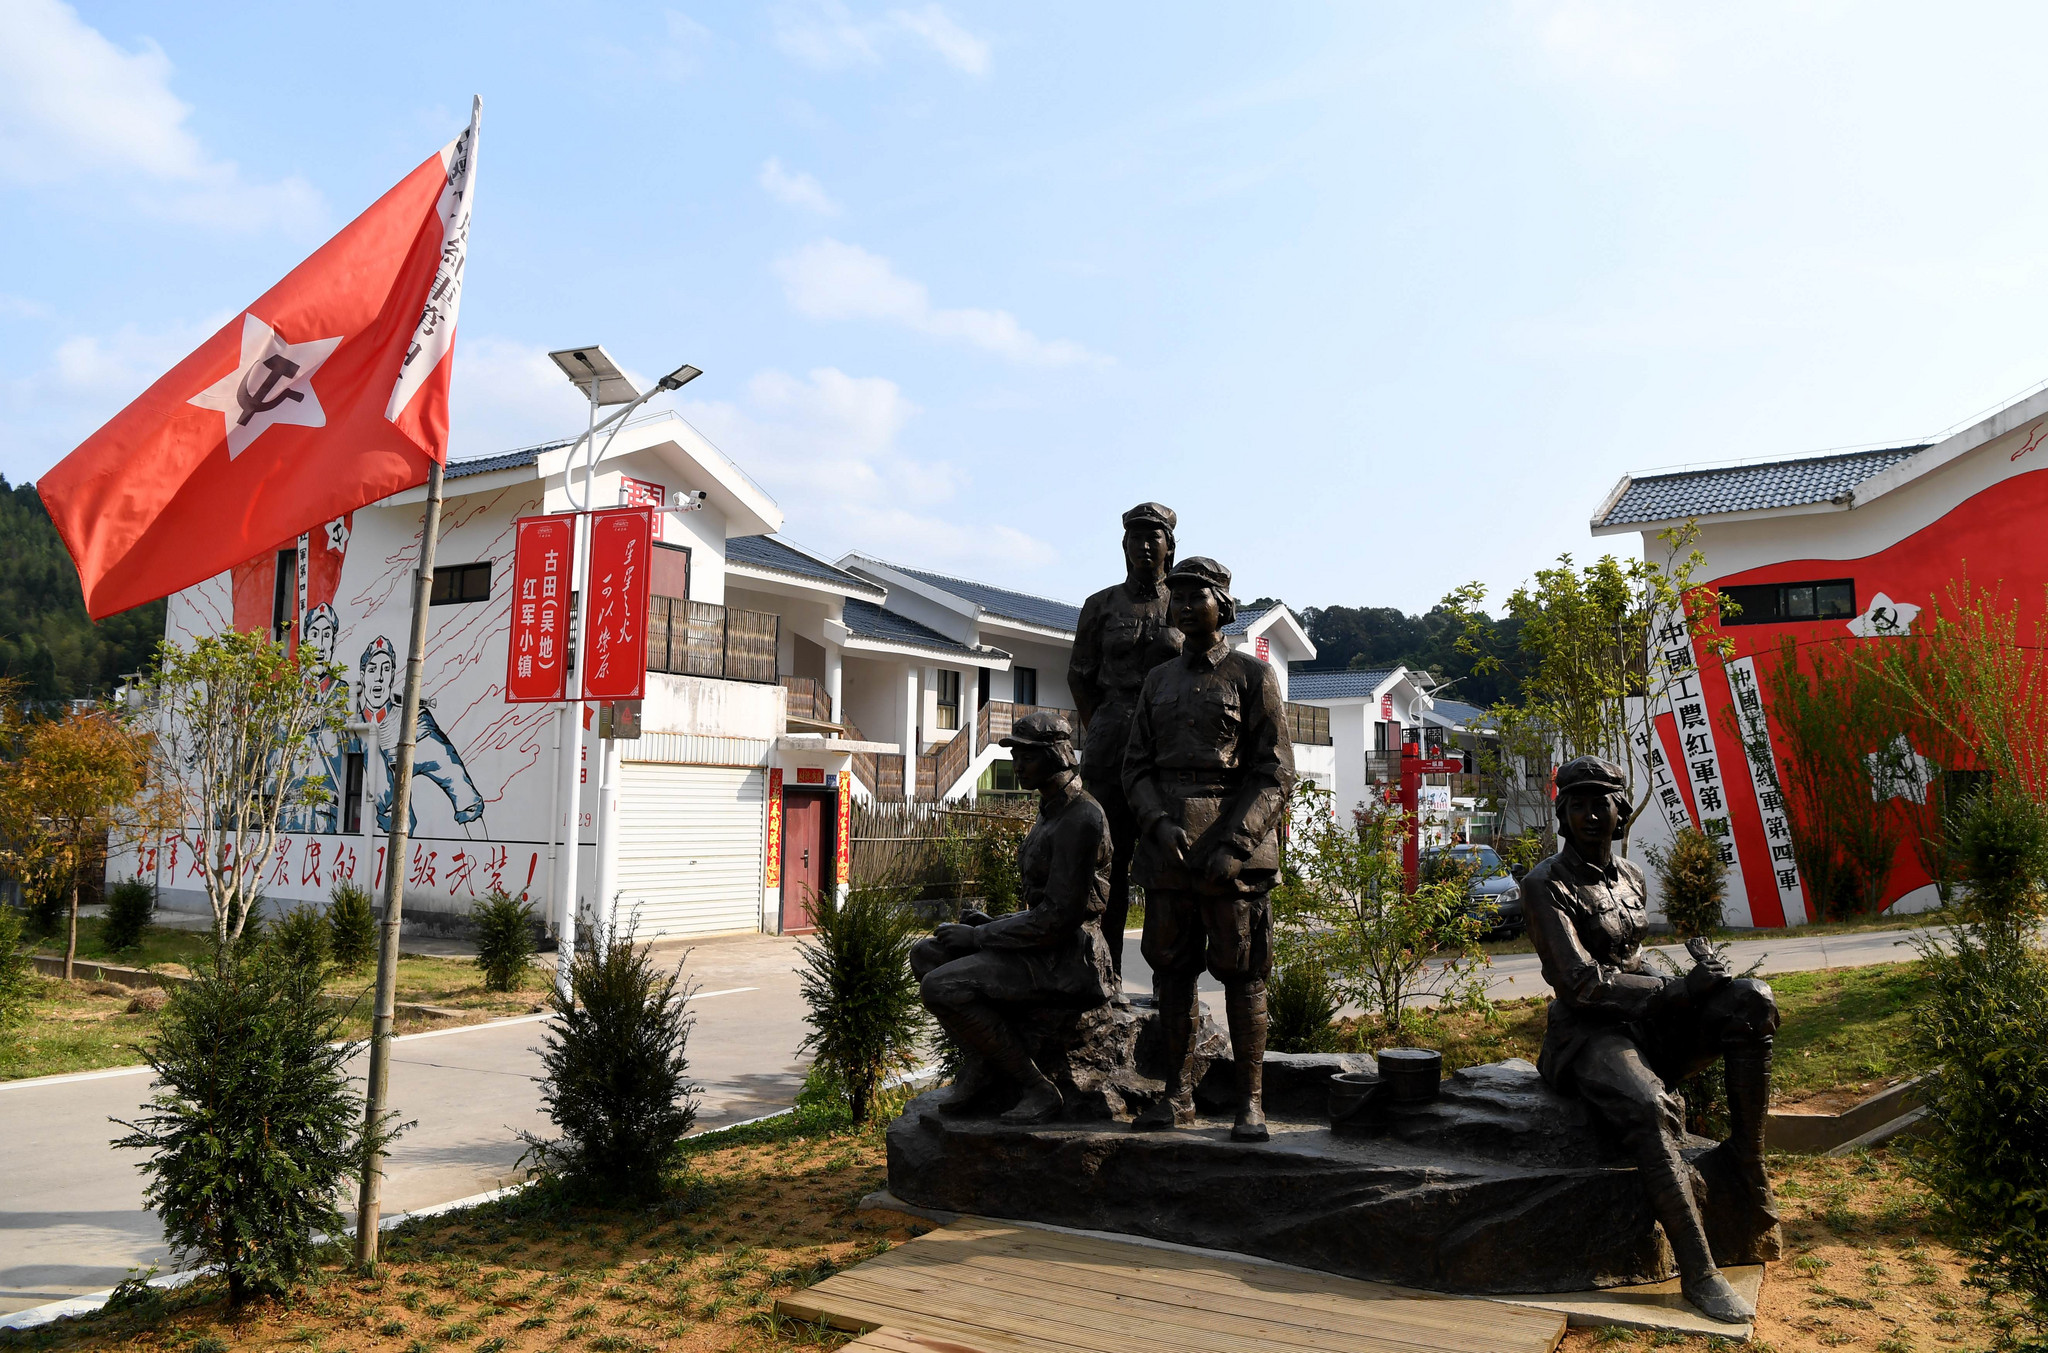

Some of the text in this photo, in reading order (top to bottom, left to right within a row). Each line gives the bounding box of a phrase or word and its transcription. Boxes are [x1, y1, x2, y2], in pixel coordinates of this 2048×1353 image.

[517, 577, 538, 679] 红军小镇
[594, 573, 614, 680] 可以燎原
[616, 538, 637, 644] 星星之火
[563, 812, 592, 828] 129
